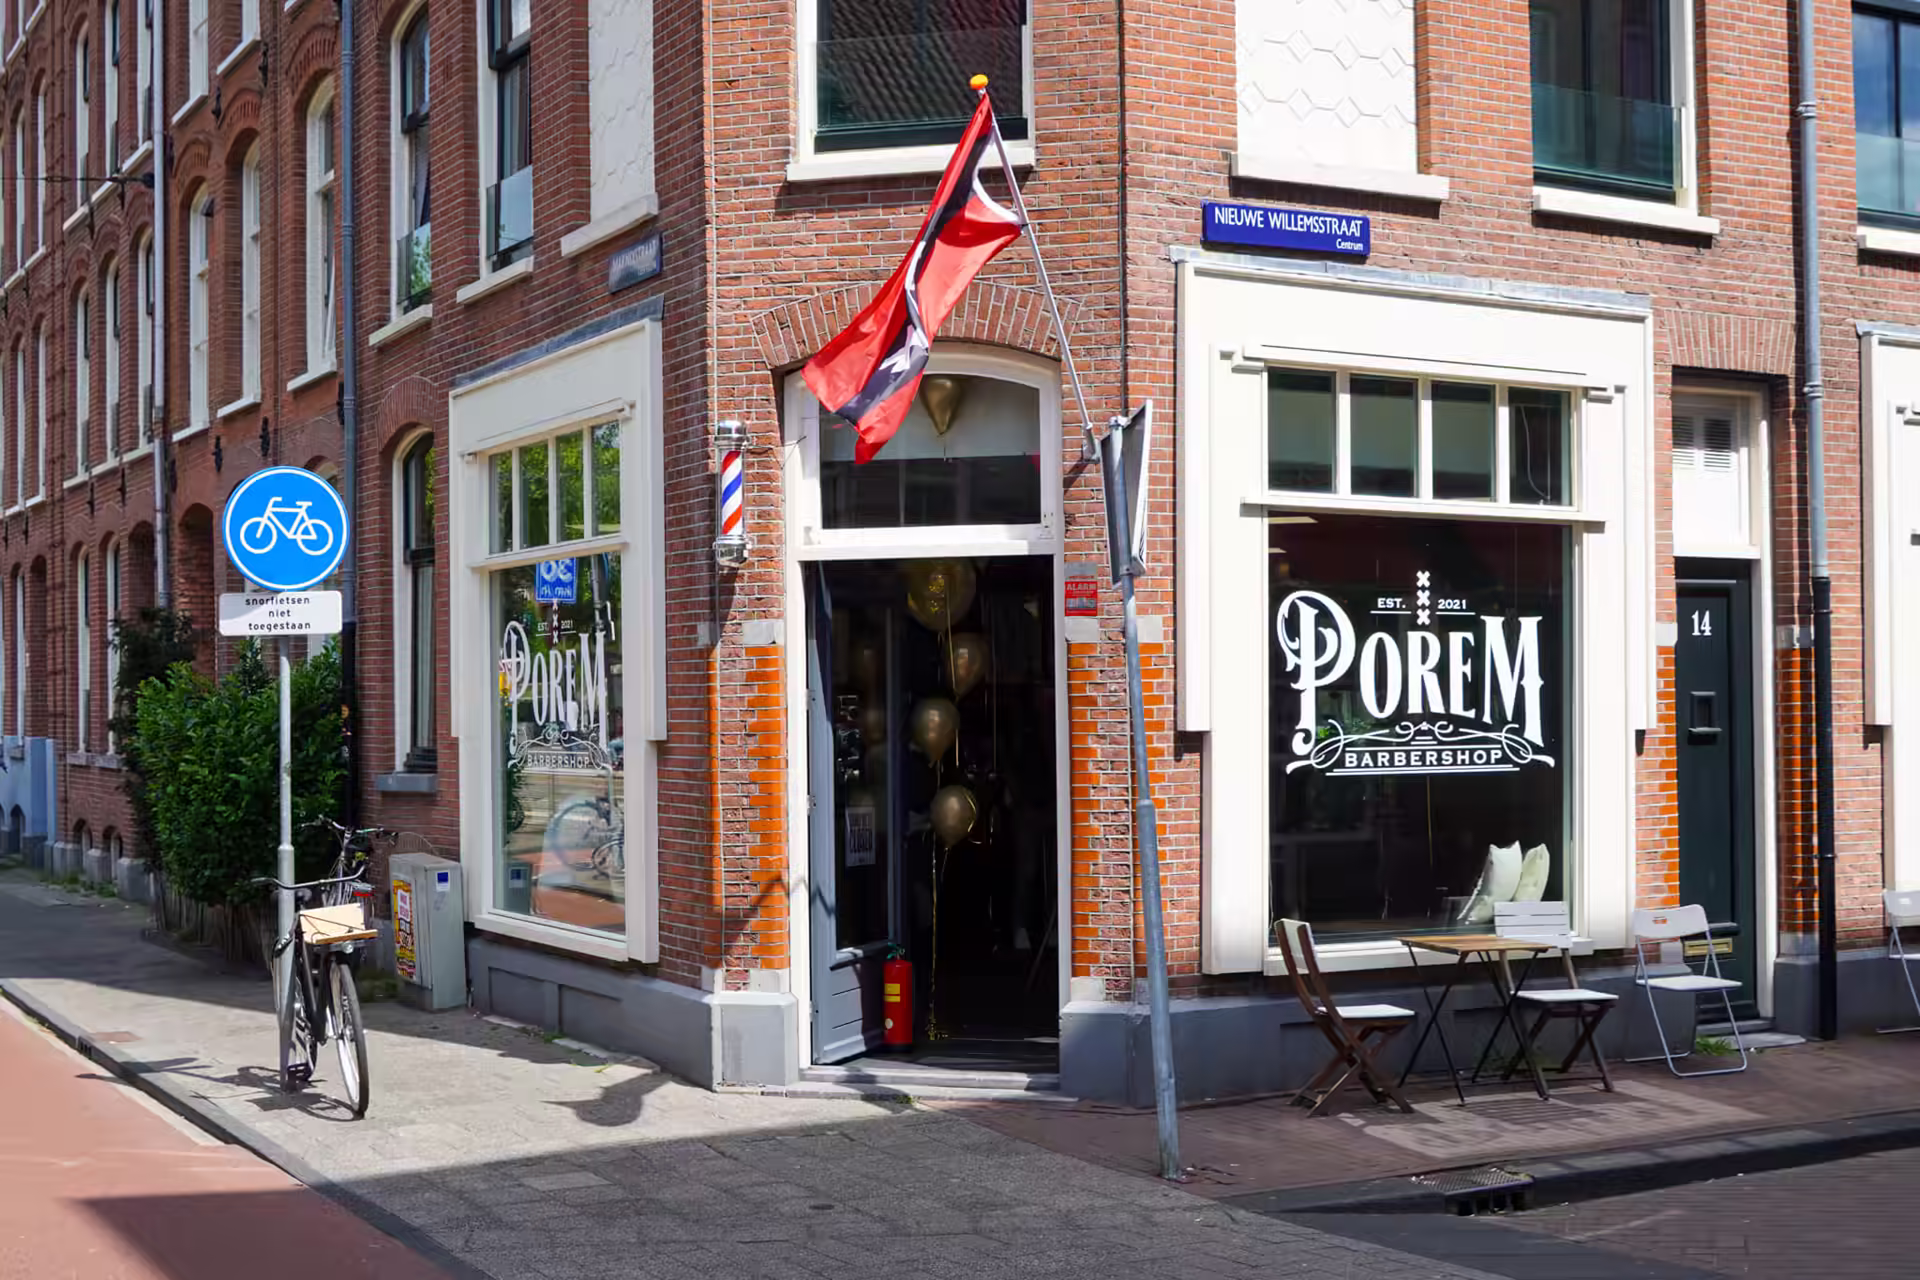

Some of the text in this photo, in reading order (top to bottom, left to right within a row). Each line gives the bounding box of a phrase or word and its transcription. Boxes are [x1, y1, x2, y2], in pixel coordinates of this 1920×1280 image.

[1214, 207, 1362, 237] NIEUWE WILLEMSSTRAAT
[1336, 238, 1364, 251] Centrum
[245, 596, 310, 606] snorfietsen
[1377, 597, 1467, 610] EST. 2021
[268, 609, 291, 618] niet
[248, 621, 311, 632] toegestaan
[560, 618, 574, 630] 2021
[1691, 609, 1712, 636] 14
[1277, 590, 1544, 756] POREM
[503, 620, 609, 755] POREM
[527, 754, 589, 769] BARBERSHOP
[1344, 749, 1503, 768] BARBERSHOP
